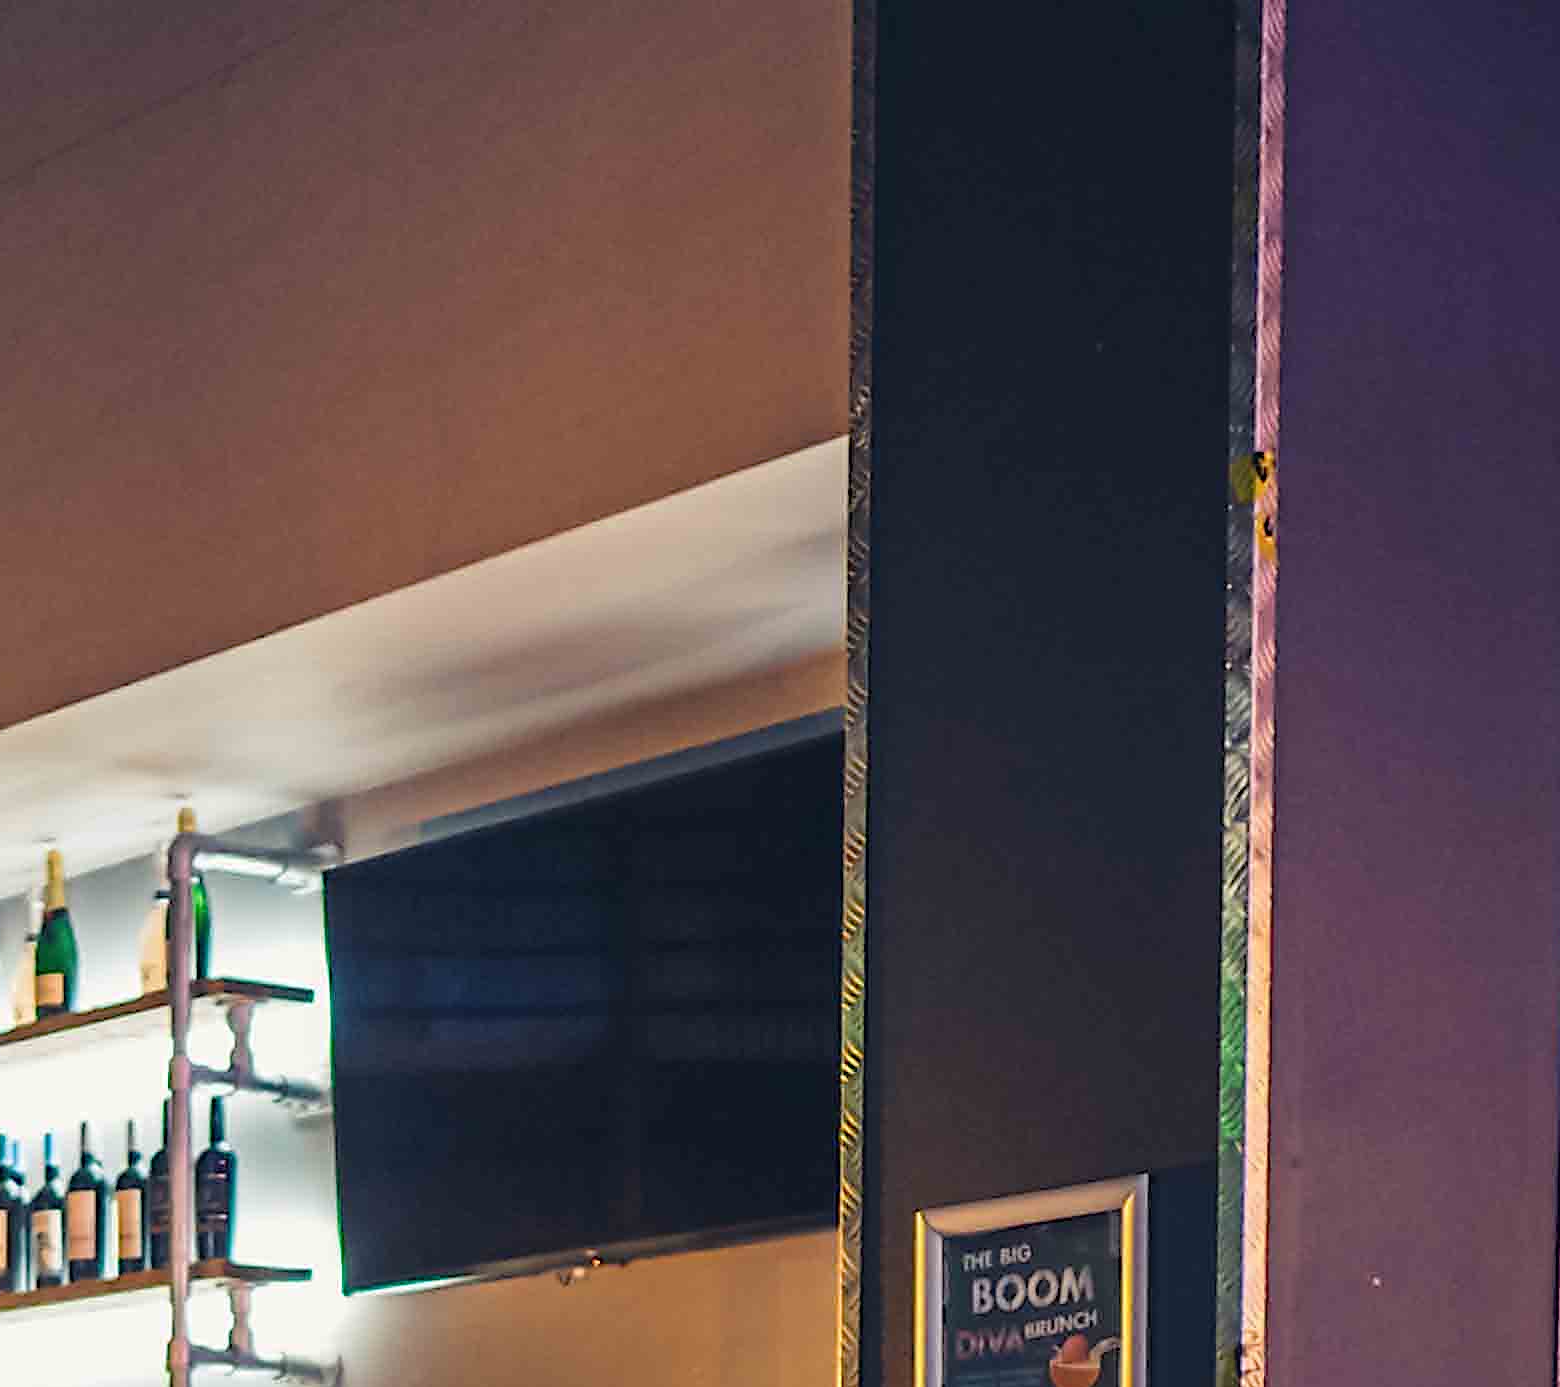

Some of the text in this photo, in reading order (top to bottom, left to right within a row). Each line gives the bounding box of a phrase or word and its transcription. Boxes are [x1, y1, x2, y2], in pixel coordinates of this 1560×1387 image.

[964, 1242, 1031, 1271] THE BIG
[972, 1267, 1094, 1314] BOOM
[1025, 1310, 1097, 1338] BRUNCH
[956, 1326, 1024, 1359] DIVA
